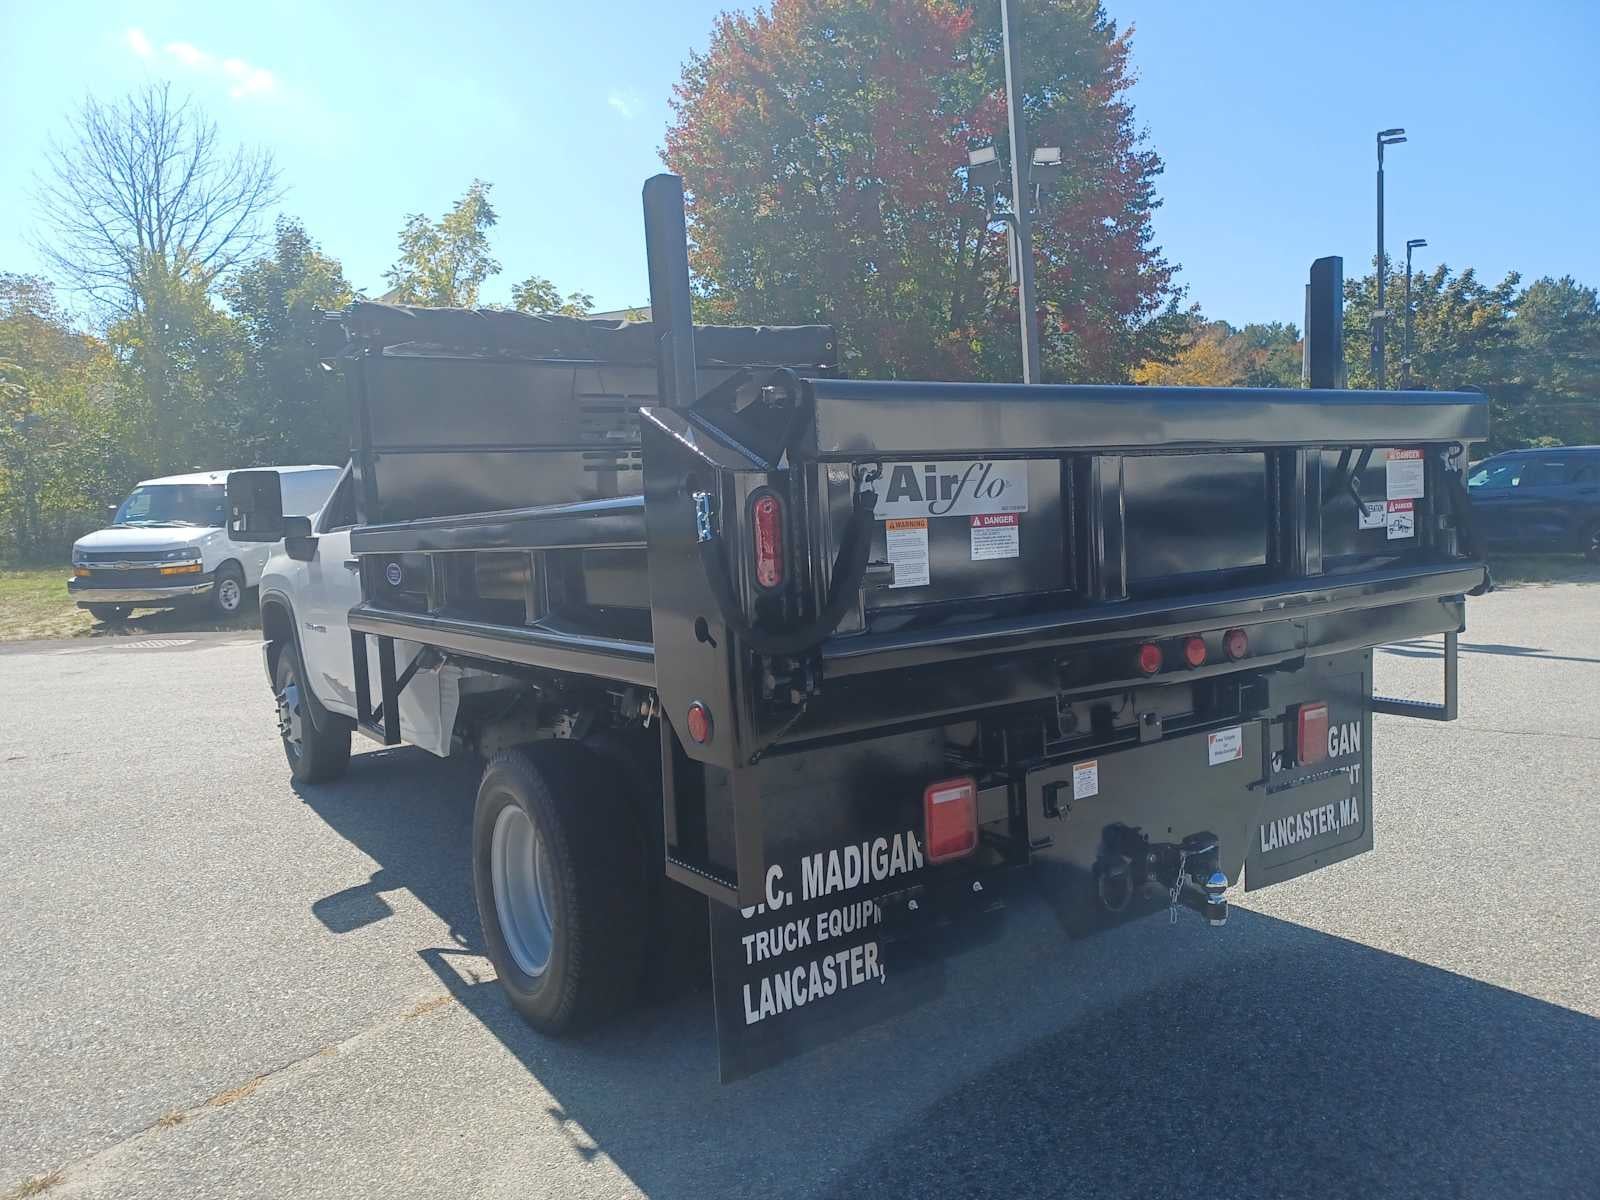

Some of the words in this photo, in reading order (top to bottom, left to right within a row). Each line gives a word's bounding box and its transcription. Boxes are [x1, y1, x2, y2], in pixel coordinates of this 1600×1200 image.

[885, 462, 1005, 515] Airflo
[895, 519, 926, 529] WARNING
[984, 515, 1014, 525] DANGER
[741, 864, 793, 919] .C.
[801, 831, 924, 902] MADIGAN
[742, 917, 811, 965] TRUCK
